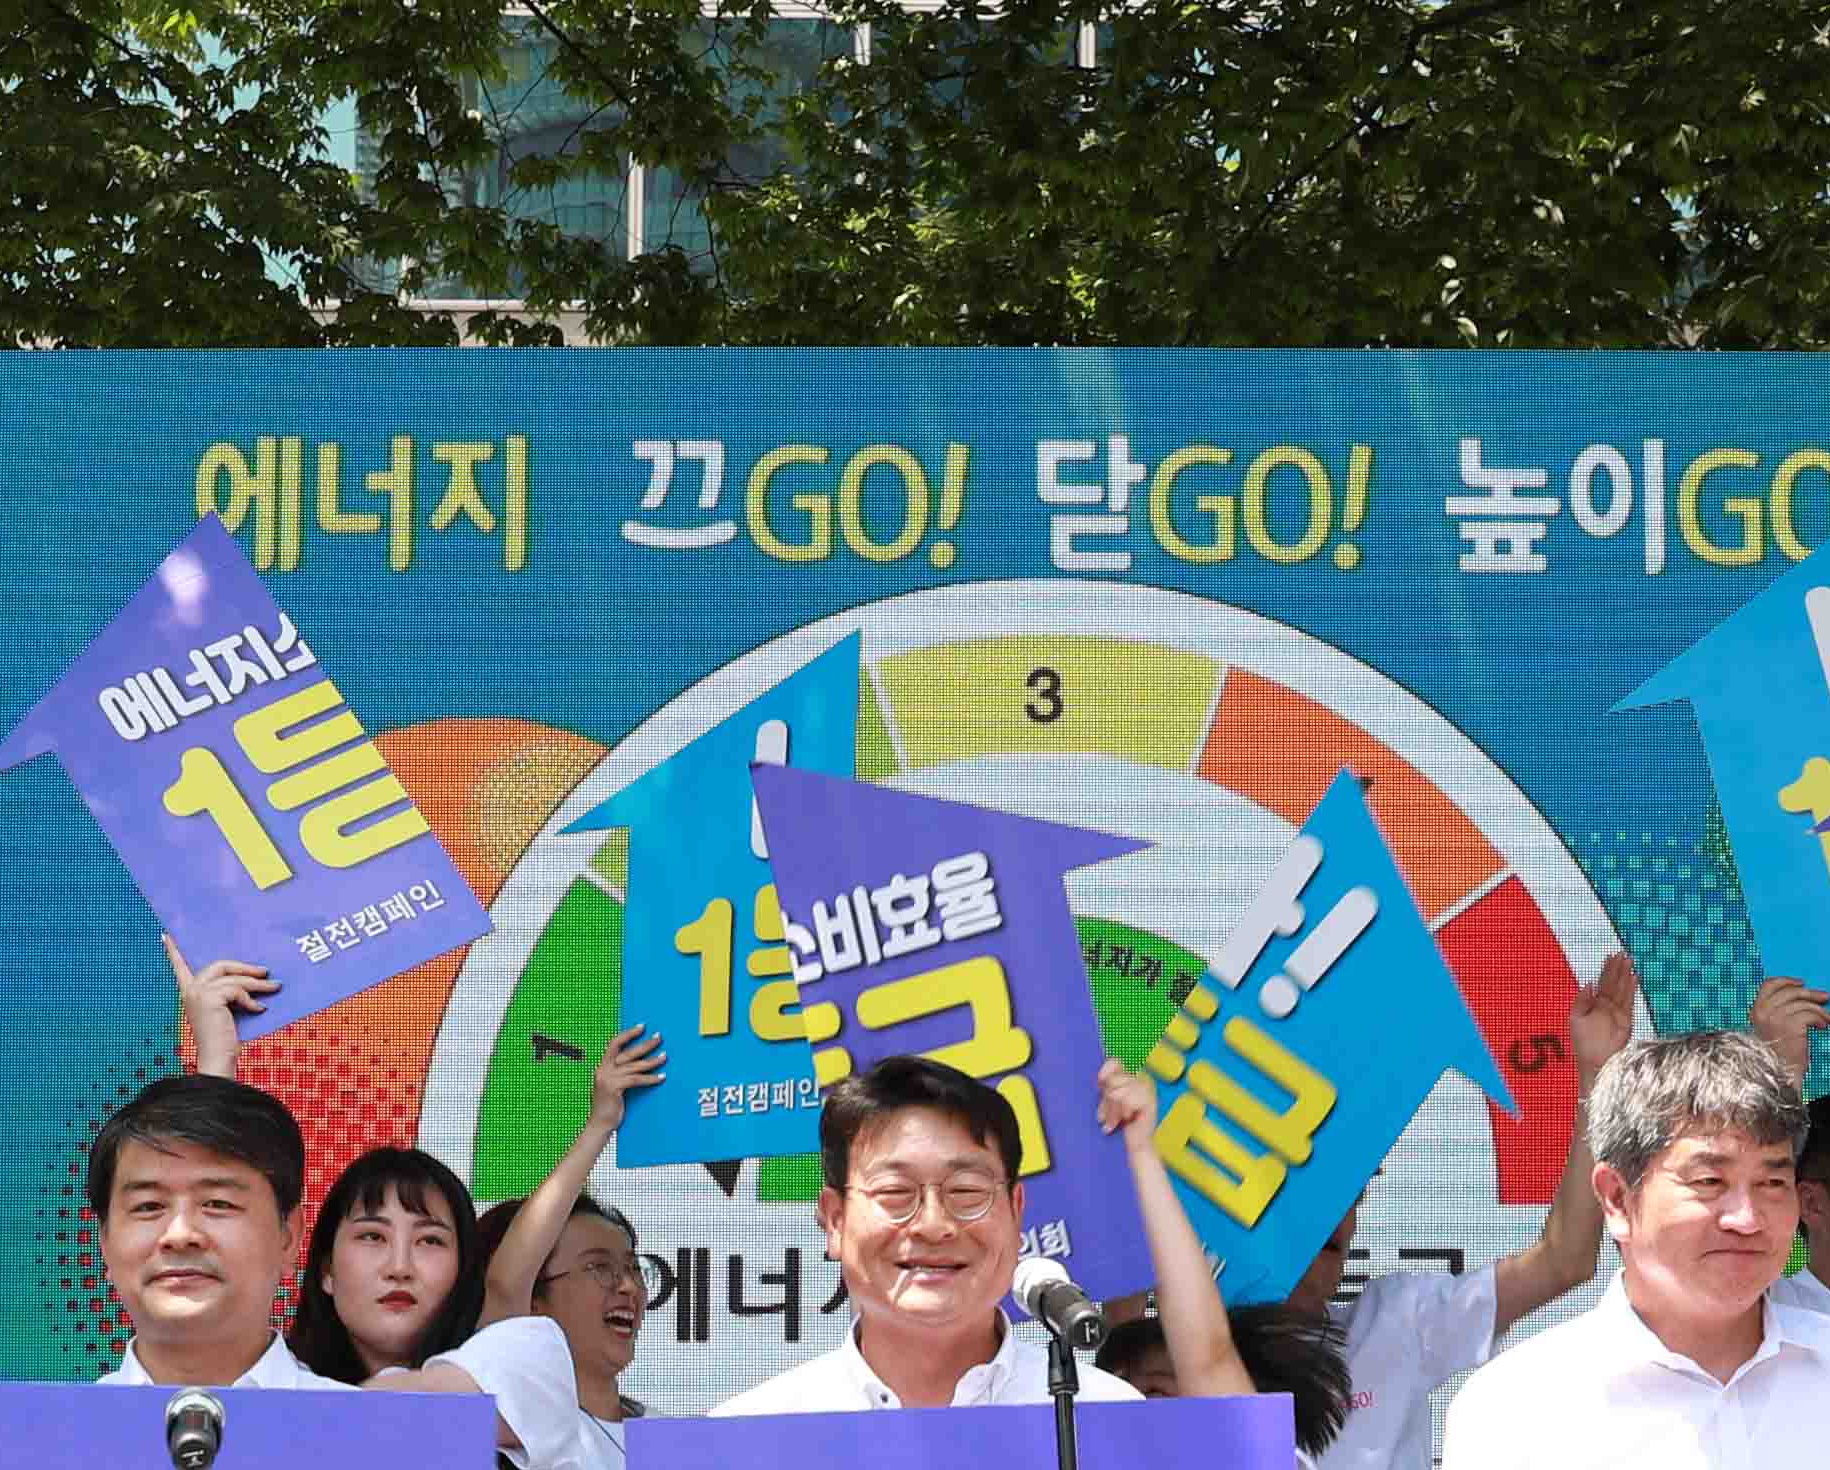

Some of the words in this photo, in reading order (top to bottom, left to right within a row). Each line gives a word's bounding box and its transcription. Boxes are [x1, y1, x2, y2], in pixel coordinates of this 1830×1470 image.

[195, 436, 529, 571] 에너지
[621, 440, 967, 569] 끄GO!
[1037, 436, 1372, 571] 닫GO!
[1024, 667, 1064, 723] 3
[297, 879, 446, 964] 절전캠페인
[1509, 1033, 1566, 1073] 5
[698, 1076, 822, 1118] 절전캠페인
